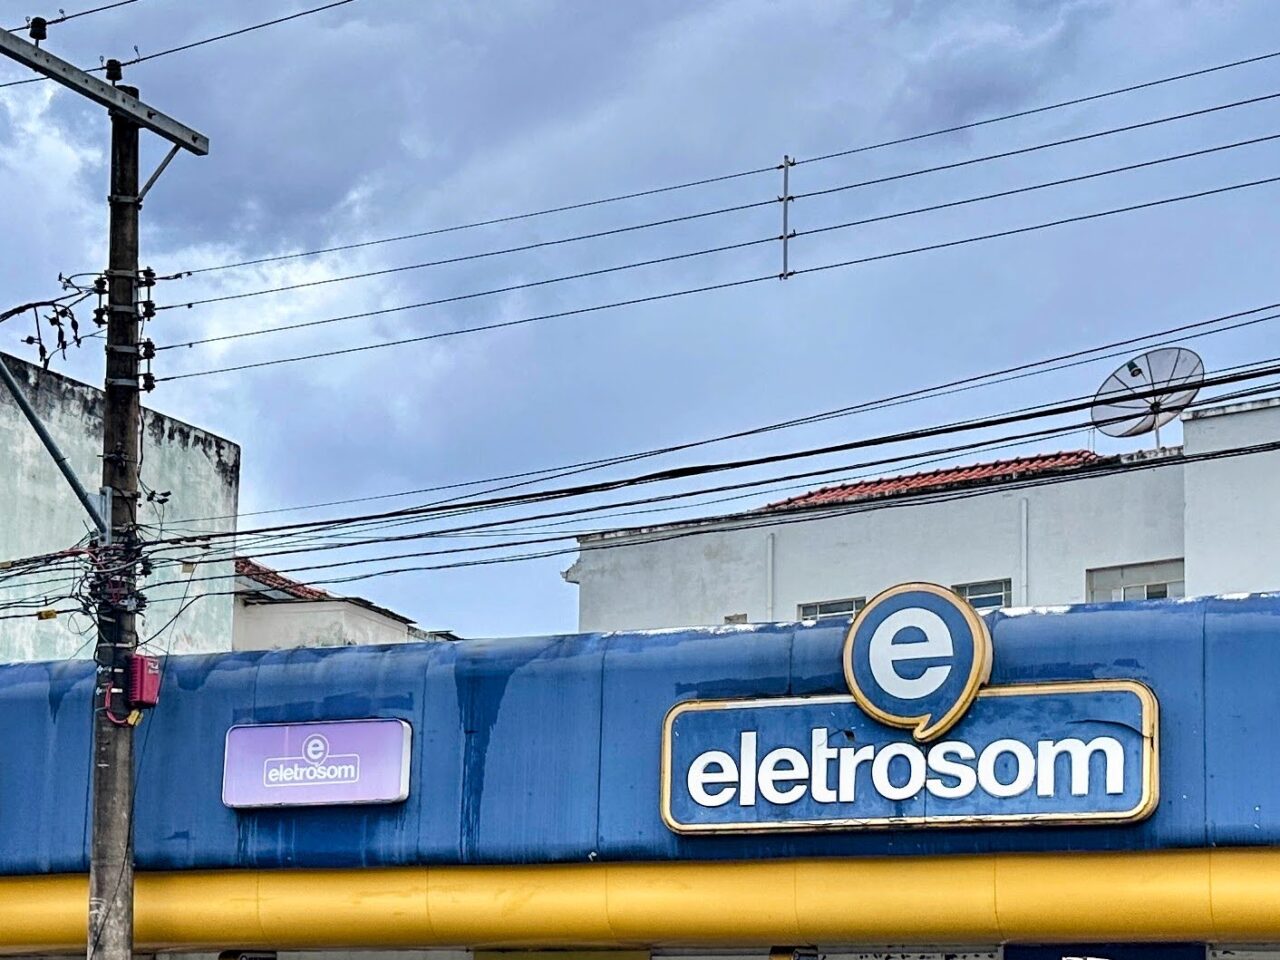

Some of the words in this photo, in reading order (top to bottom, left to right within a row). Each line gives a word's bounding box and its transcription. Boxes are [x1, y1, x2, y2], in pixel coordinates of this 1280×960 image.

[869, 607, 954, 699] e
[268, 764, 355, 782] eletrosom
[307, 739, 325, 760] e
[687, 727, 1125, 807] eletrosom
